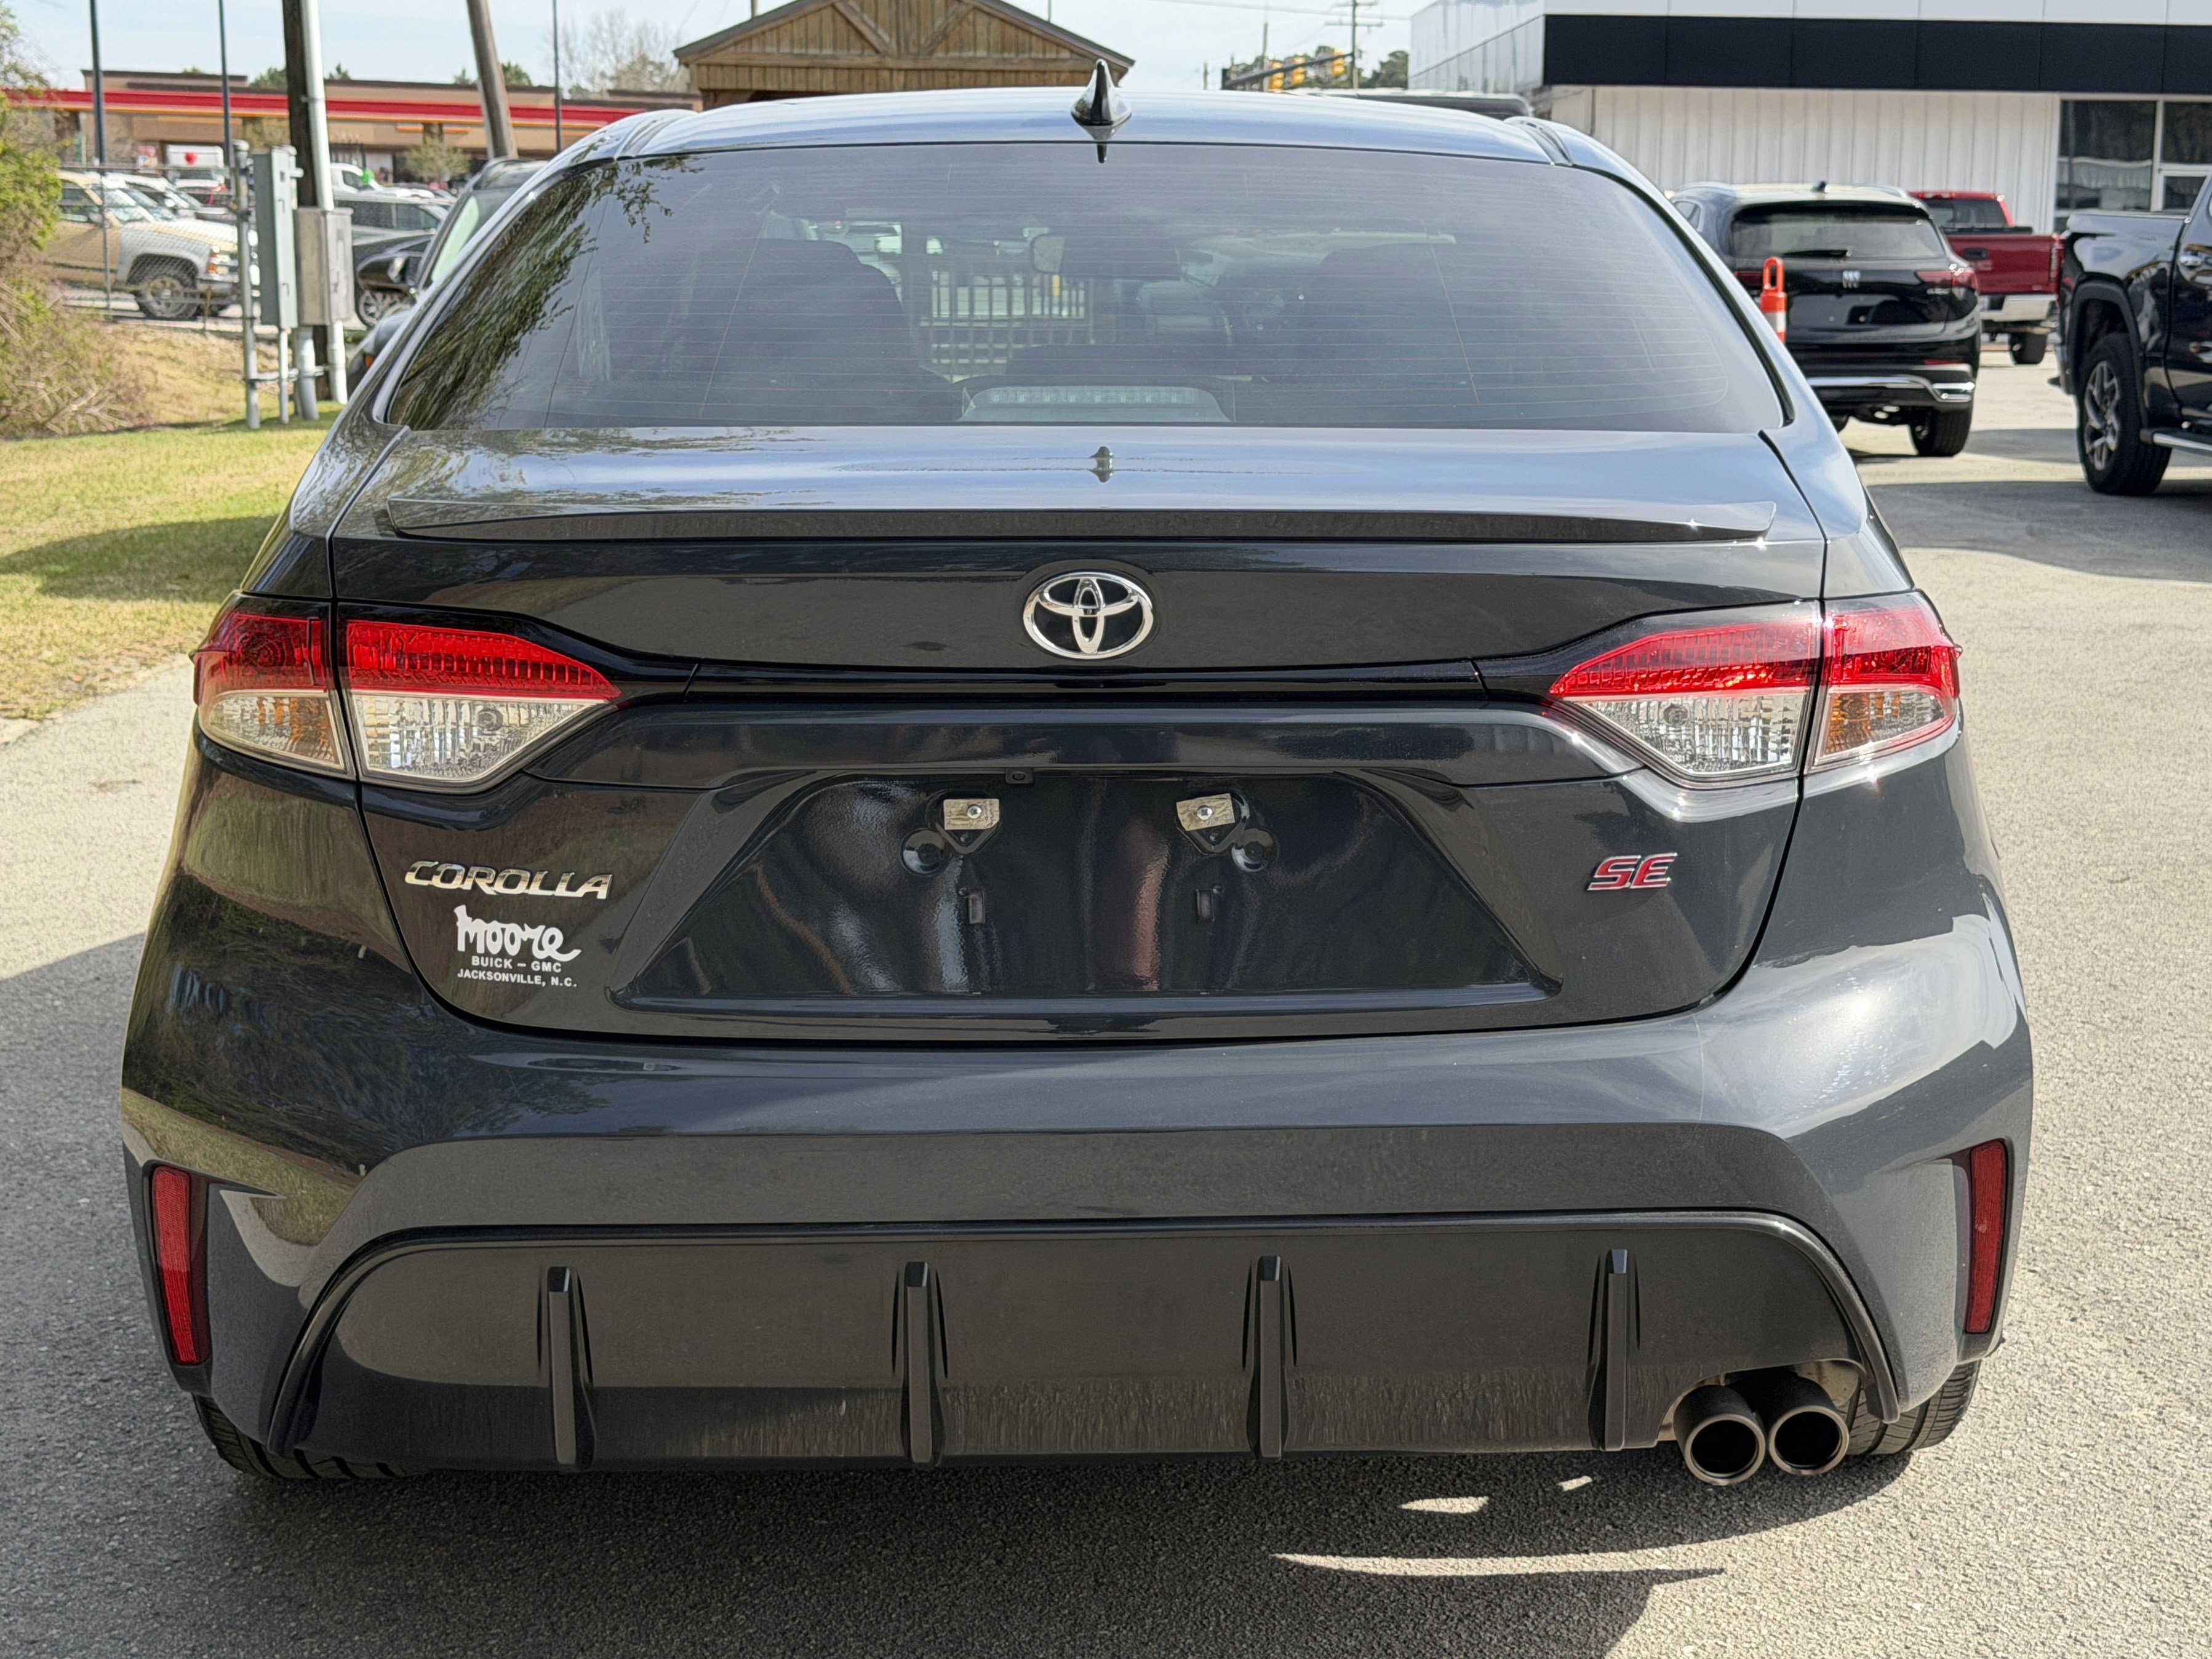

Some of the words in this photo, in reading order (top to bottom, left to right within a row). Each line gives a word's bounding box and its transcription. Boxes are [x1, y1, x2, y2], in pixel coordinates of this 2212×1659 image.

[404, 860, 613, 900] COROLLA
[1587, 852, 1678, 890] SE
[471, 955, 513, 970] BUICK
[530, 961, 562, 973] GMC
[457, 969, 546, 987] JACKSONVILLE,
[551, 976, 578, 988] N.C.
